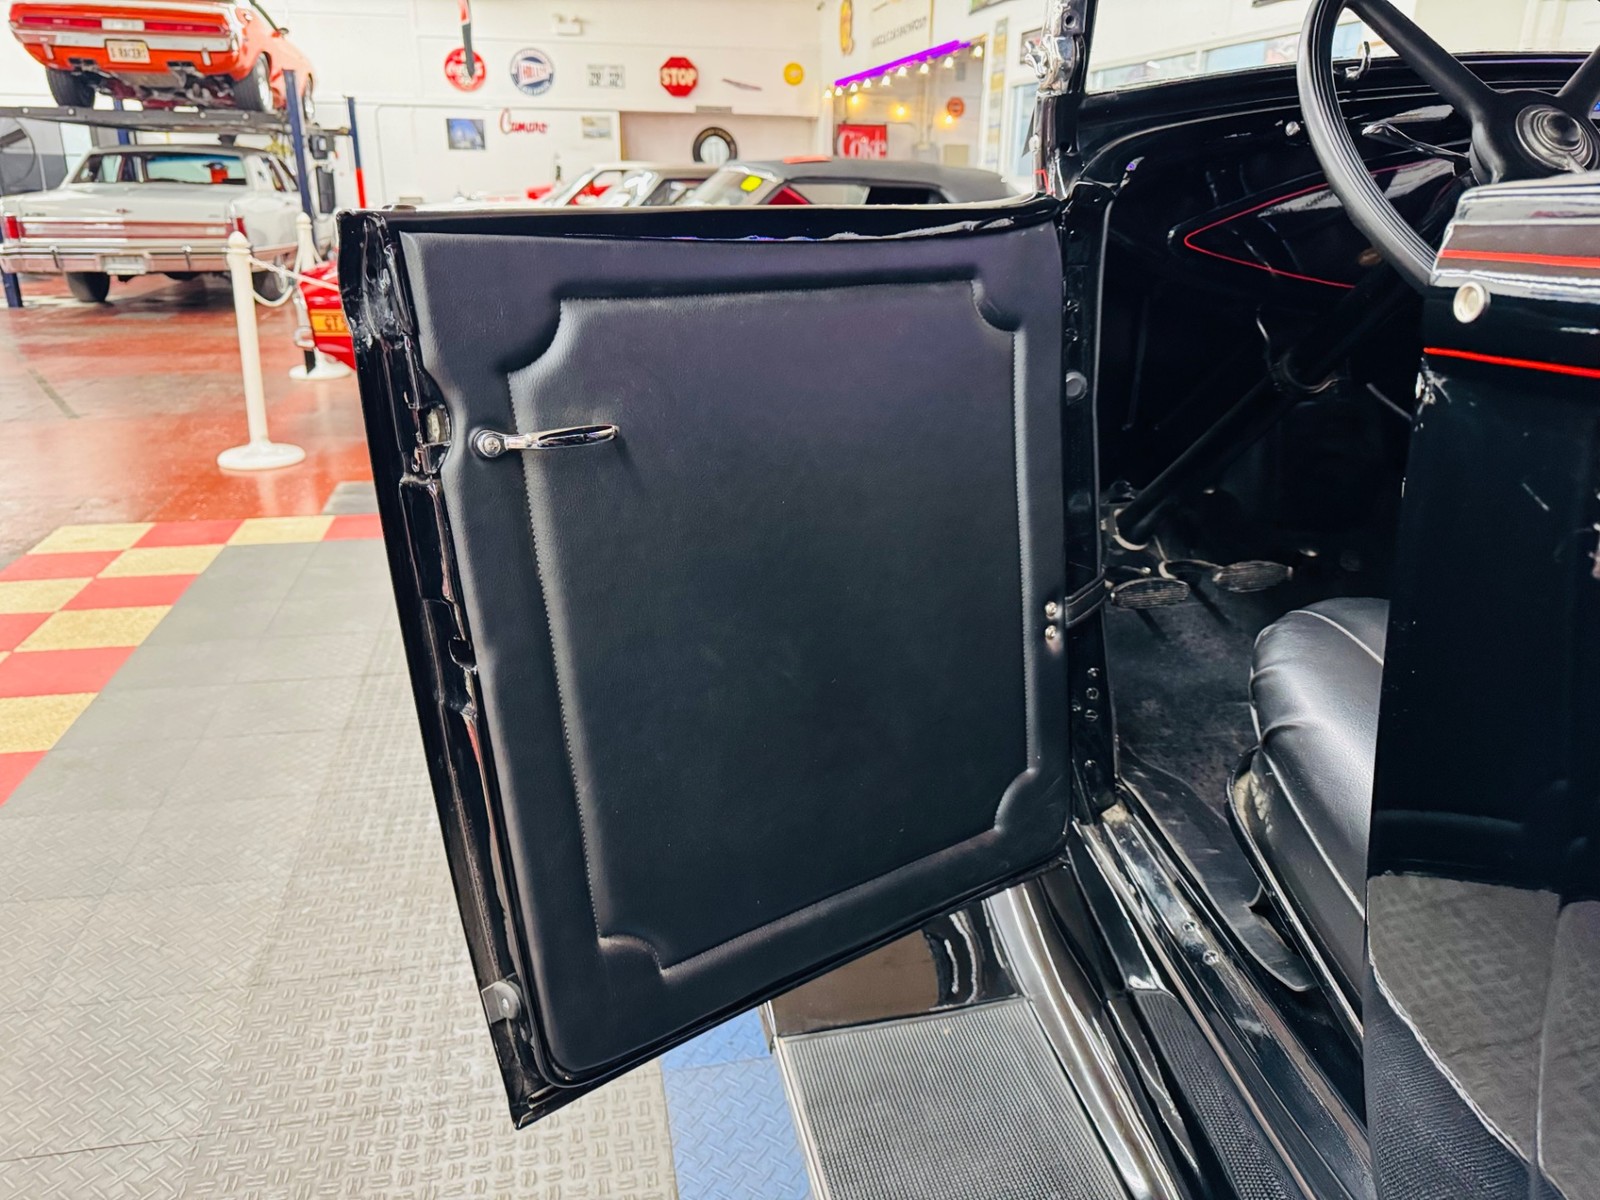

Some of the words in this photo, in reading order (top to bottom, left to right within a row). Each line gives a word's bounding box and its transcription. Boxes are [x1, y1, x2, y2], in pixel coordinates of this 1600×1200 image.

[660, 67, 698, 87] STOP
[499, 107, 549, 135] Camaro
[837, 130, 887, 159] Coke
